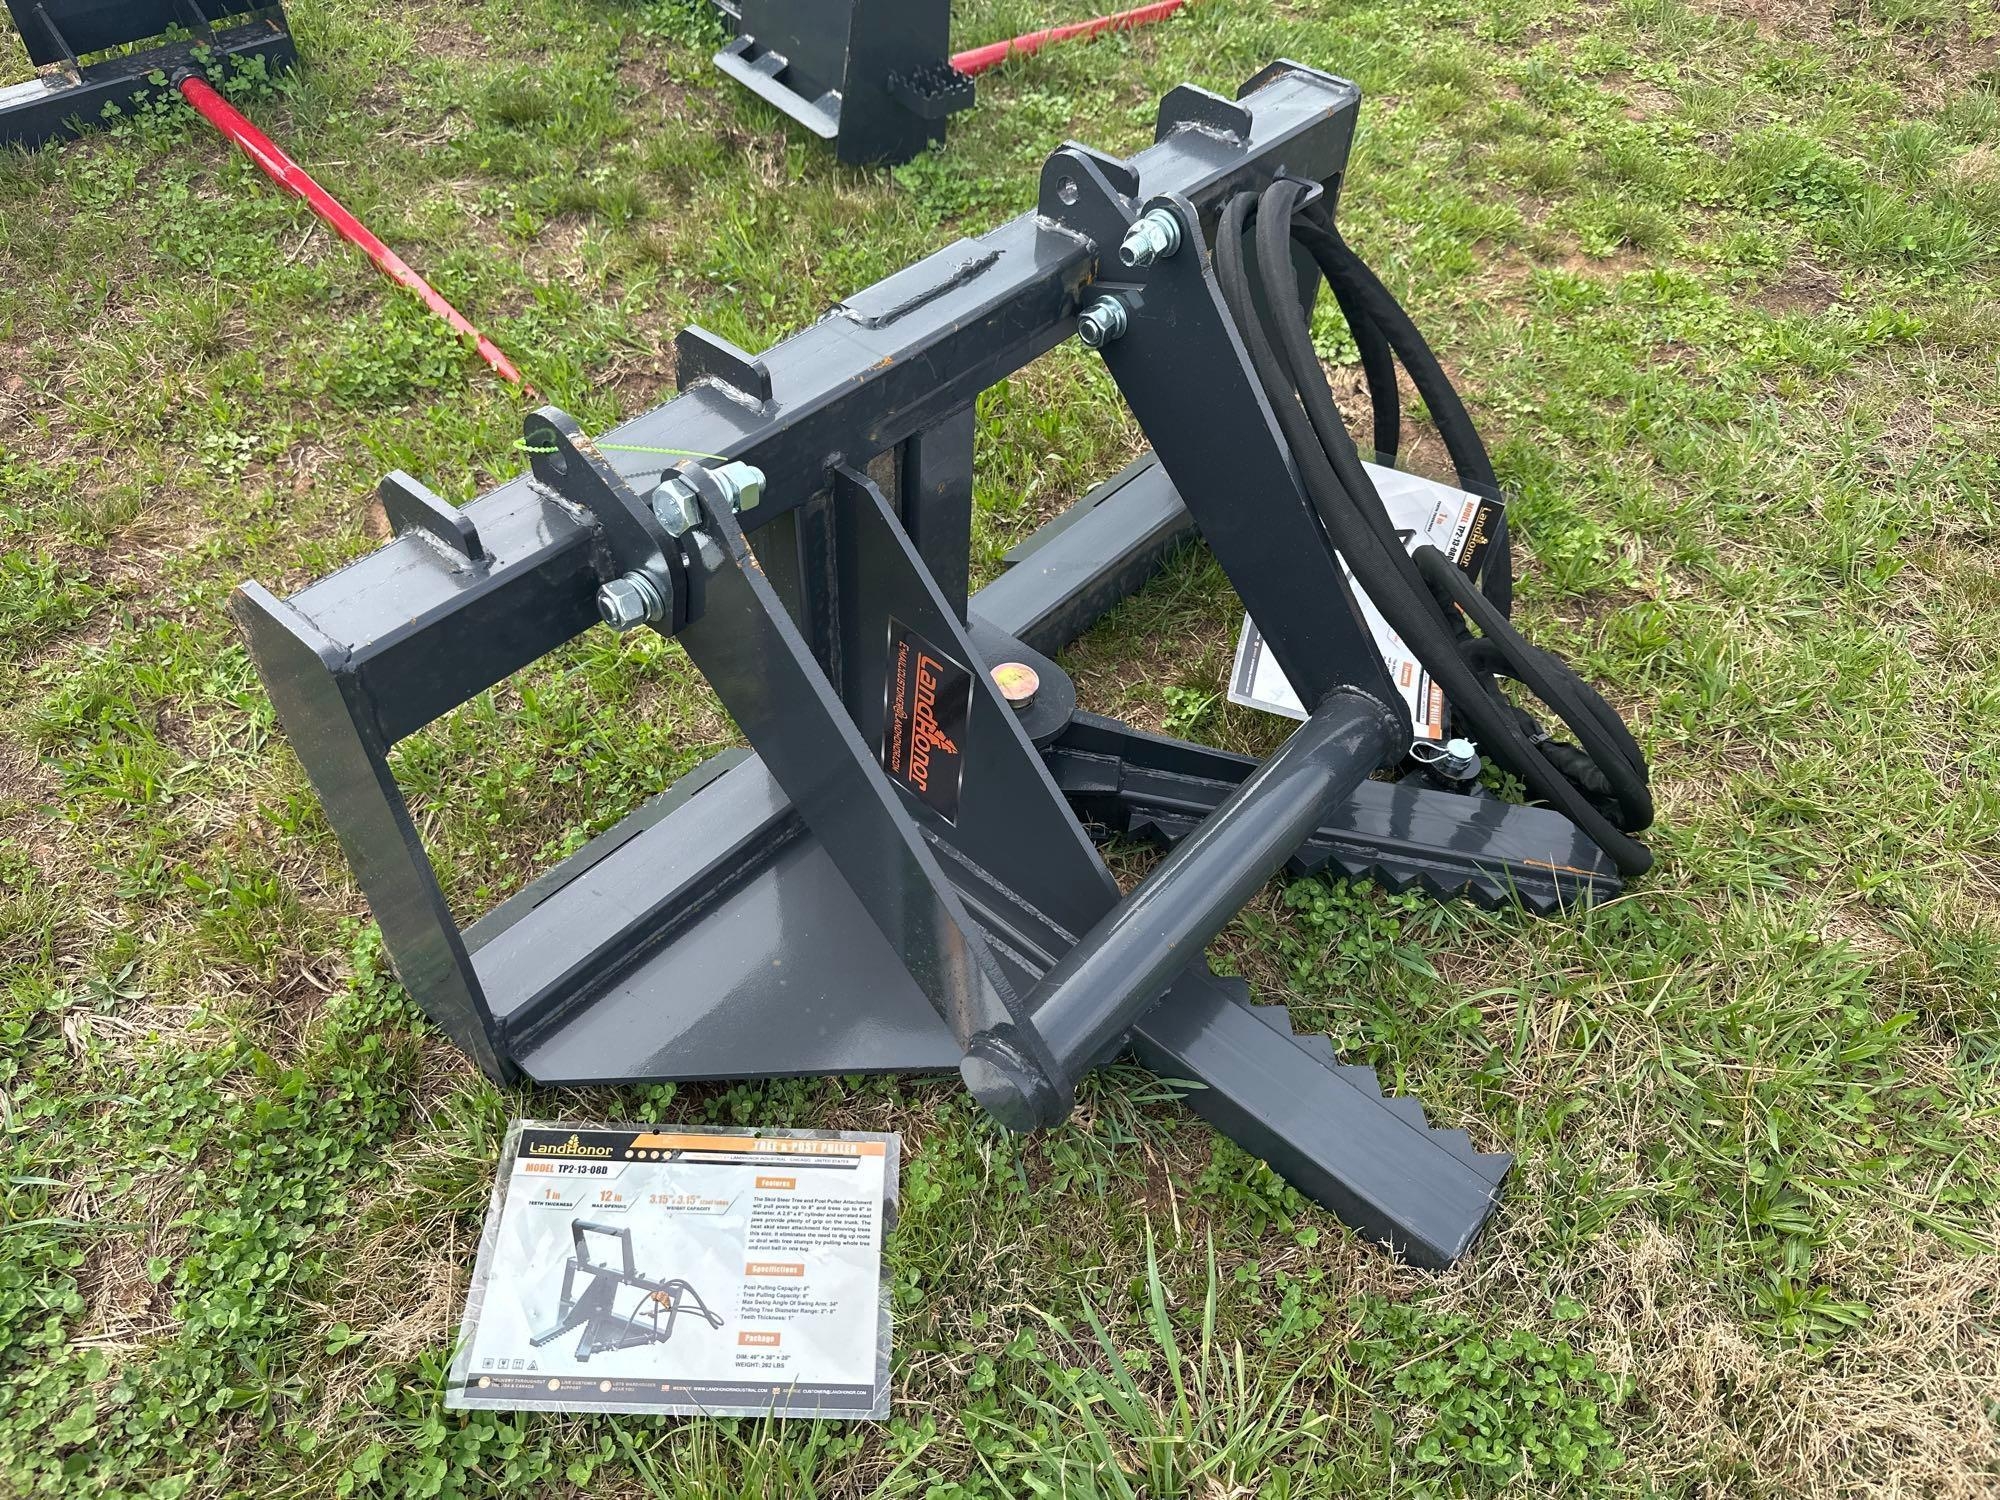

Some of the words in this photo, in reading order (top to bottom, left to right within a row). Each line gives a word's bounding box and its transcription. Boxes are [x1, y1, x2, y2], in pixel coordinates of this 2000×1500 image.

[1461, 501, 1474, 523] MODEL
[1461, 506, 1492, 567] LandHonor
[909, 653, 946, 792] LandHonor
[529, 1140, 613, 1156] LandHonor
[753, 1141, 778, 1152] TREE
[792, 1142, 817, 1153] POST
[821, 1143, 857, 1155] PULLER
[525, 1162, 554, 1173] MODEL
[558, 1164, 608, 1175] TP2-13-08D
[545, 1189, 551, 1200] 1
[600, 1190, 611, 1202] 12
